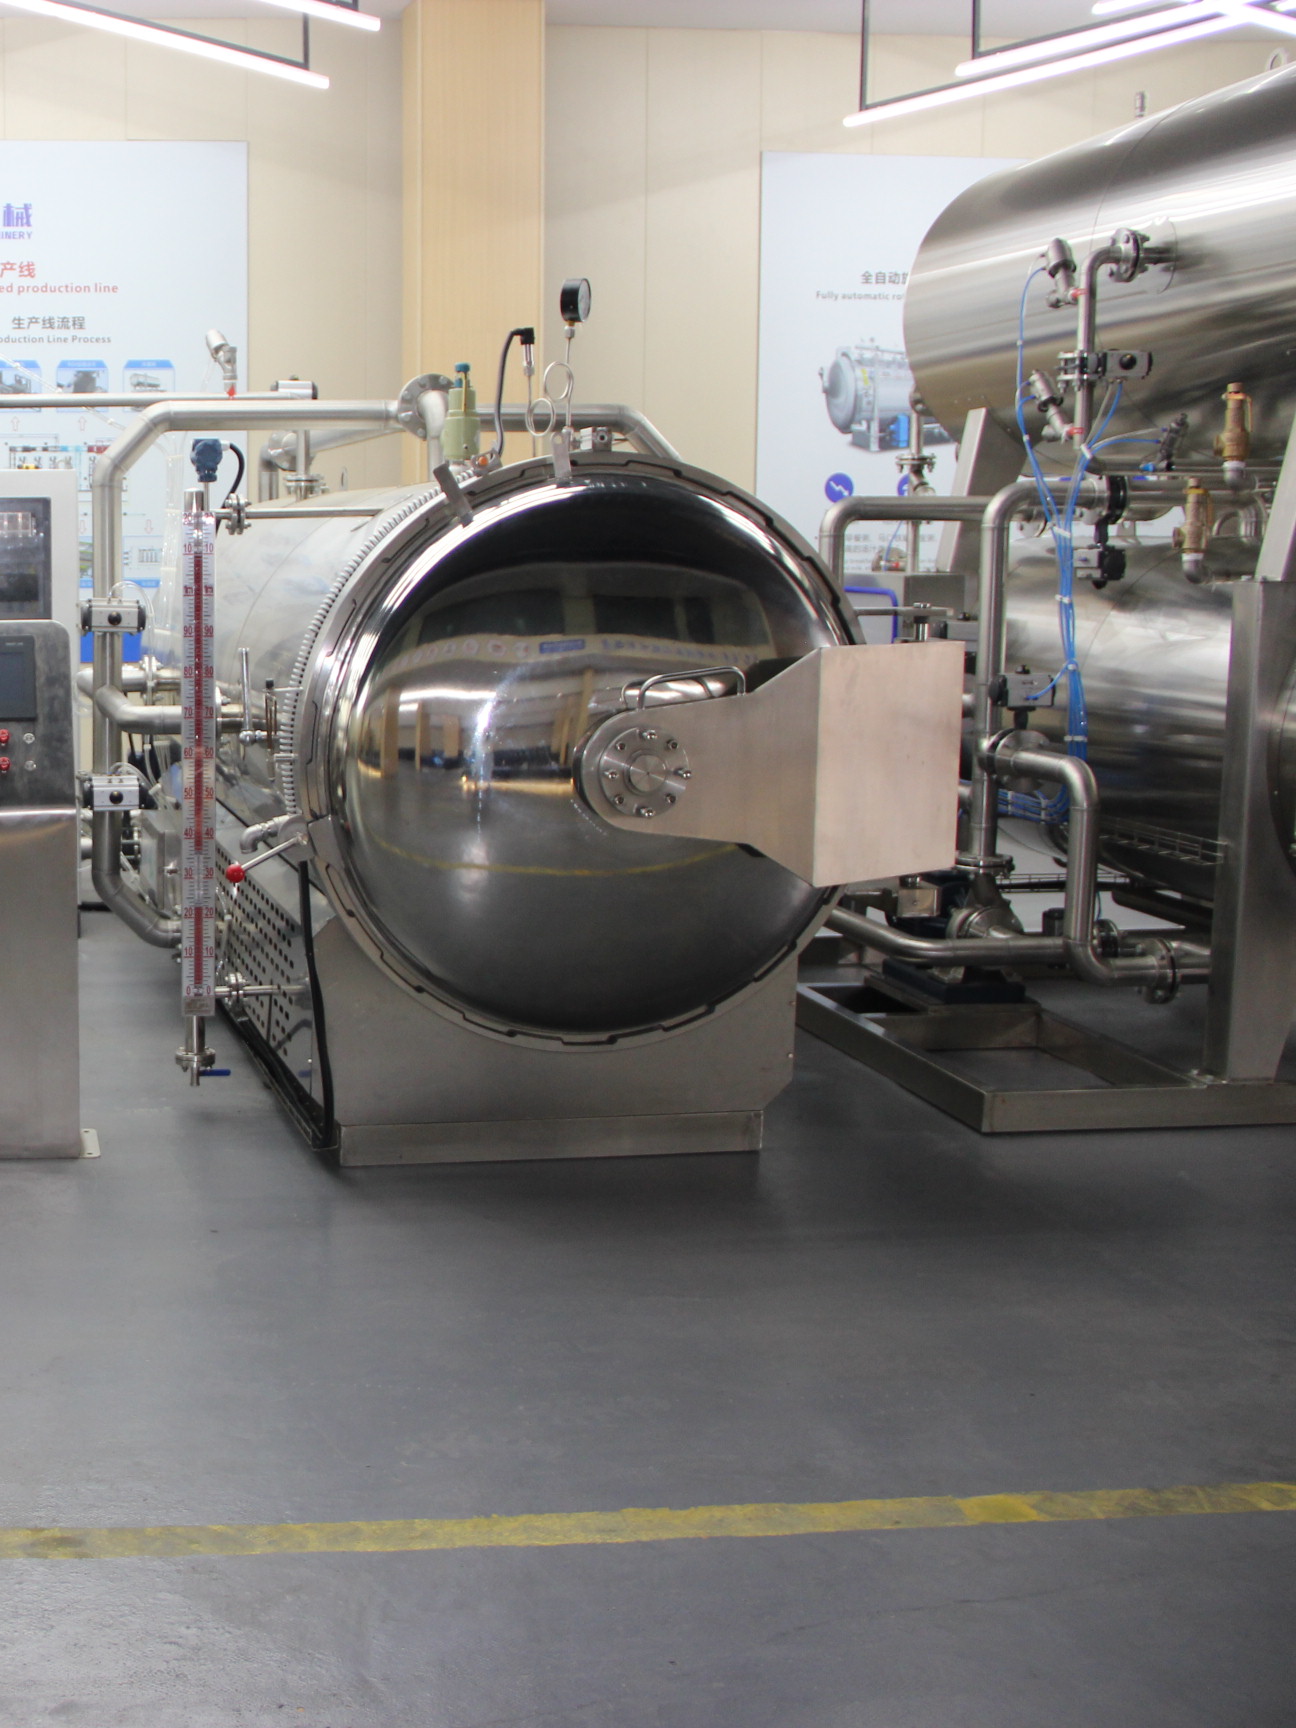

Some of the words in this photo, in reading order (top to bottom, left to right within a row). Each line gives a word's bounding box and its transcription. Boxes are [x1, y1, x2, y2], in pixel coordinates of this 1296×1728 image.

[16, 282, 91, 297] production
[94, 282, 119, 294] line
[816, 290, 838, 301] Fully
[842, 291, 889, 300] automatic
[11, 316, 86, 331] 生产线流程
[47, 335, 70, 344] Line
[71, 335, 112, 344] Process
[183, 543, 193, 553] 10
[204, 543, 214, 553] 10
[183, 626, 193, 636] 90
[204, 626, 214, 636] 90
[183, 666, 193, 676] 80
[183, 706, 193, 716] 70
[205, 706, 215, 716] 70
[183, 748, 193, 757] 60
[204, 748, 214, 757] 60
[183, 788, 193, 797] 50
[205, 788, 214, 797] 50
[183, 828, 193, 838] 40
[205, 828, 214, 838] 40
[184, 868, 193, 877] 30
[205, 868, 214, 877] 30
[184, 908, 193, 917] 20
[205, 908, 214, 917] 20
[184, 947, 193, 956] 10
[205, 947, 214, 956] 10
[185, 985, 191, 995] 0
[206, 985, 211, 995] 0
